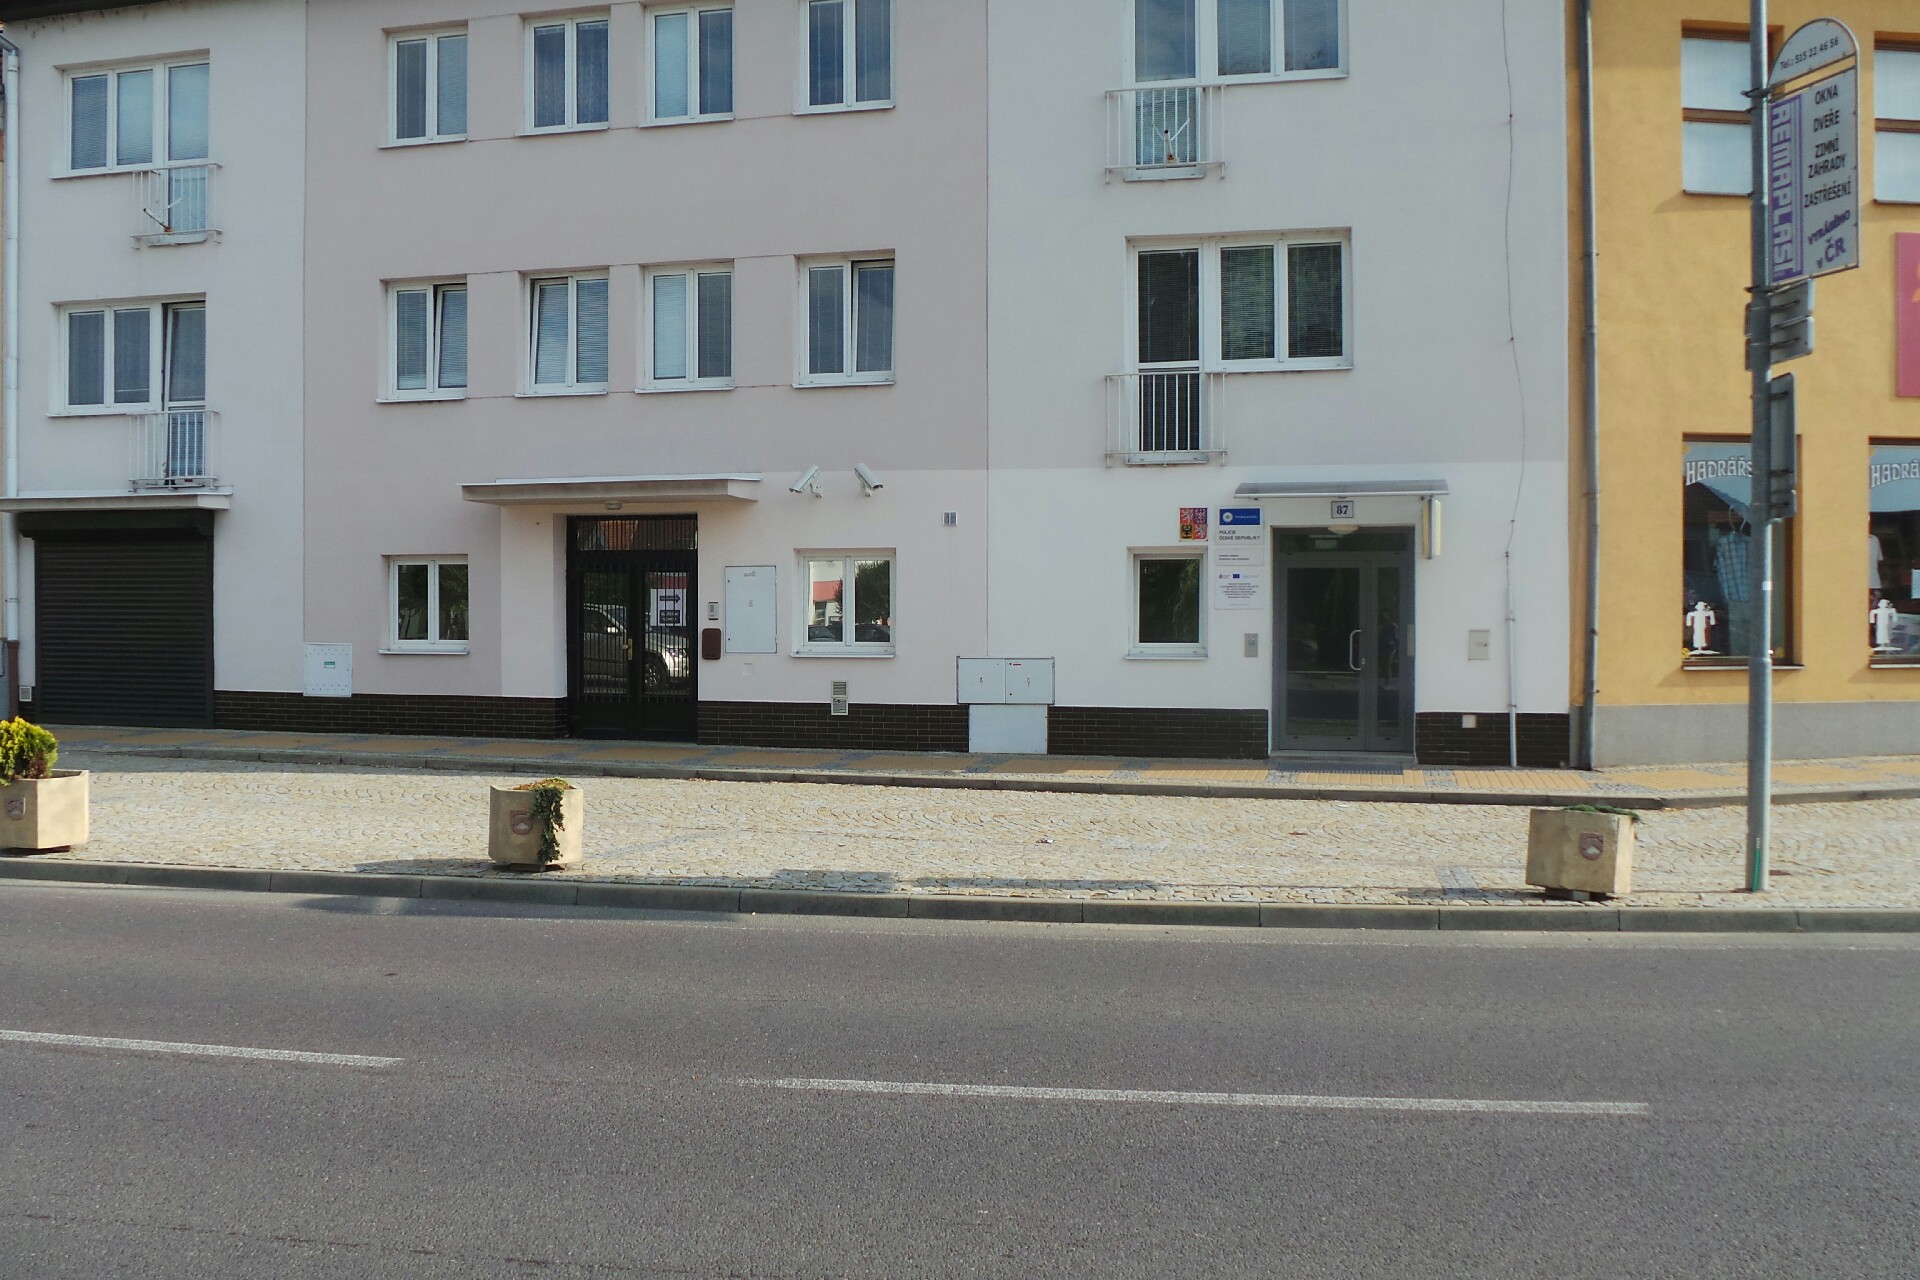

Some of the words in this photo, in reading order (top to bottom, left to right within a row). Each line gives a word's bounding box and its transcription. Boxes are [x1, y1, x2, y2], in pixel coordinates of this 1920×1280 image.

[1795, 51, 1807, 64] 515
[1809, 46, 1818, 58] 22
[1820, 41, 1829, 52] 46
[1830, 36, 1839, 48] 56
[1815, 84, 1839, 105] OKNA
[1813, 108, 1840, 132] DVEŘE
[1815, 133, 1839, 159] ZIMNÍ
[1808, 153, 1846, 179] ZAHRADY
[1772, 104, 1793, 272] REMAPLAST
[1804, 175, 1851, 208] ZASTŘEŠENÍ
[1824, 236, 1846, 263] ČR
[1336, 504, 1349, 515] 87
